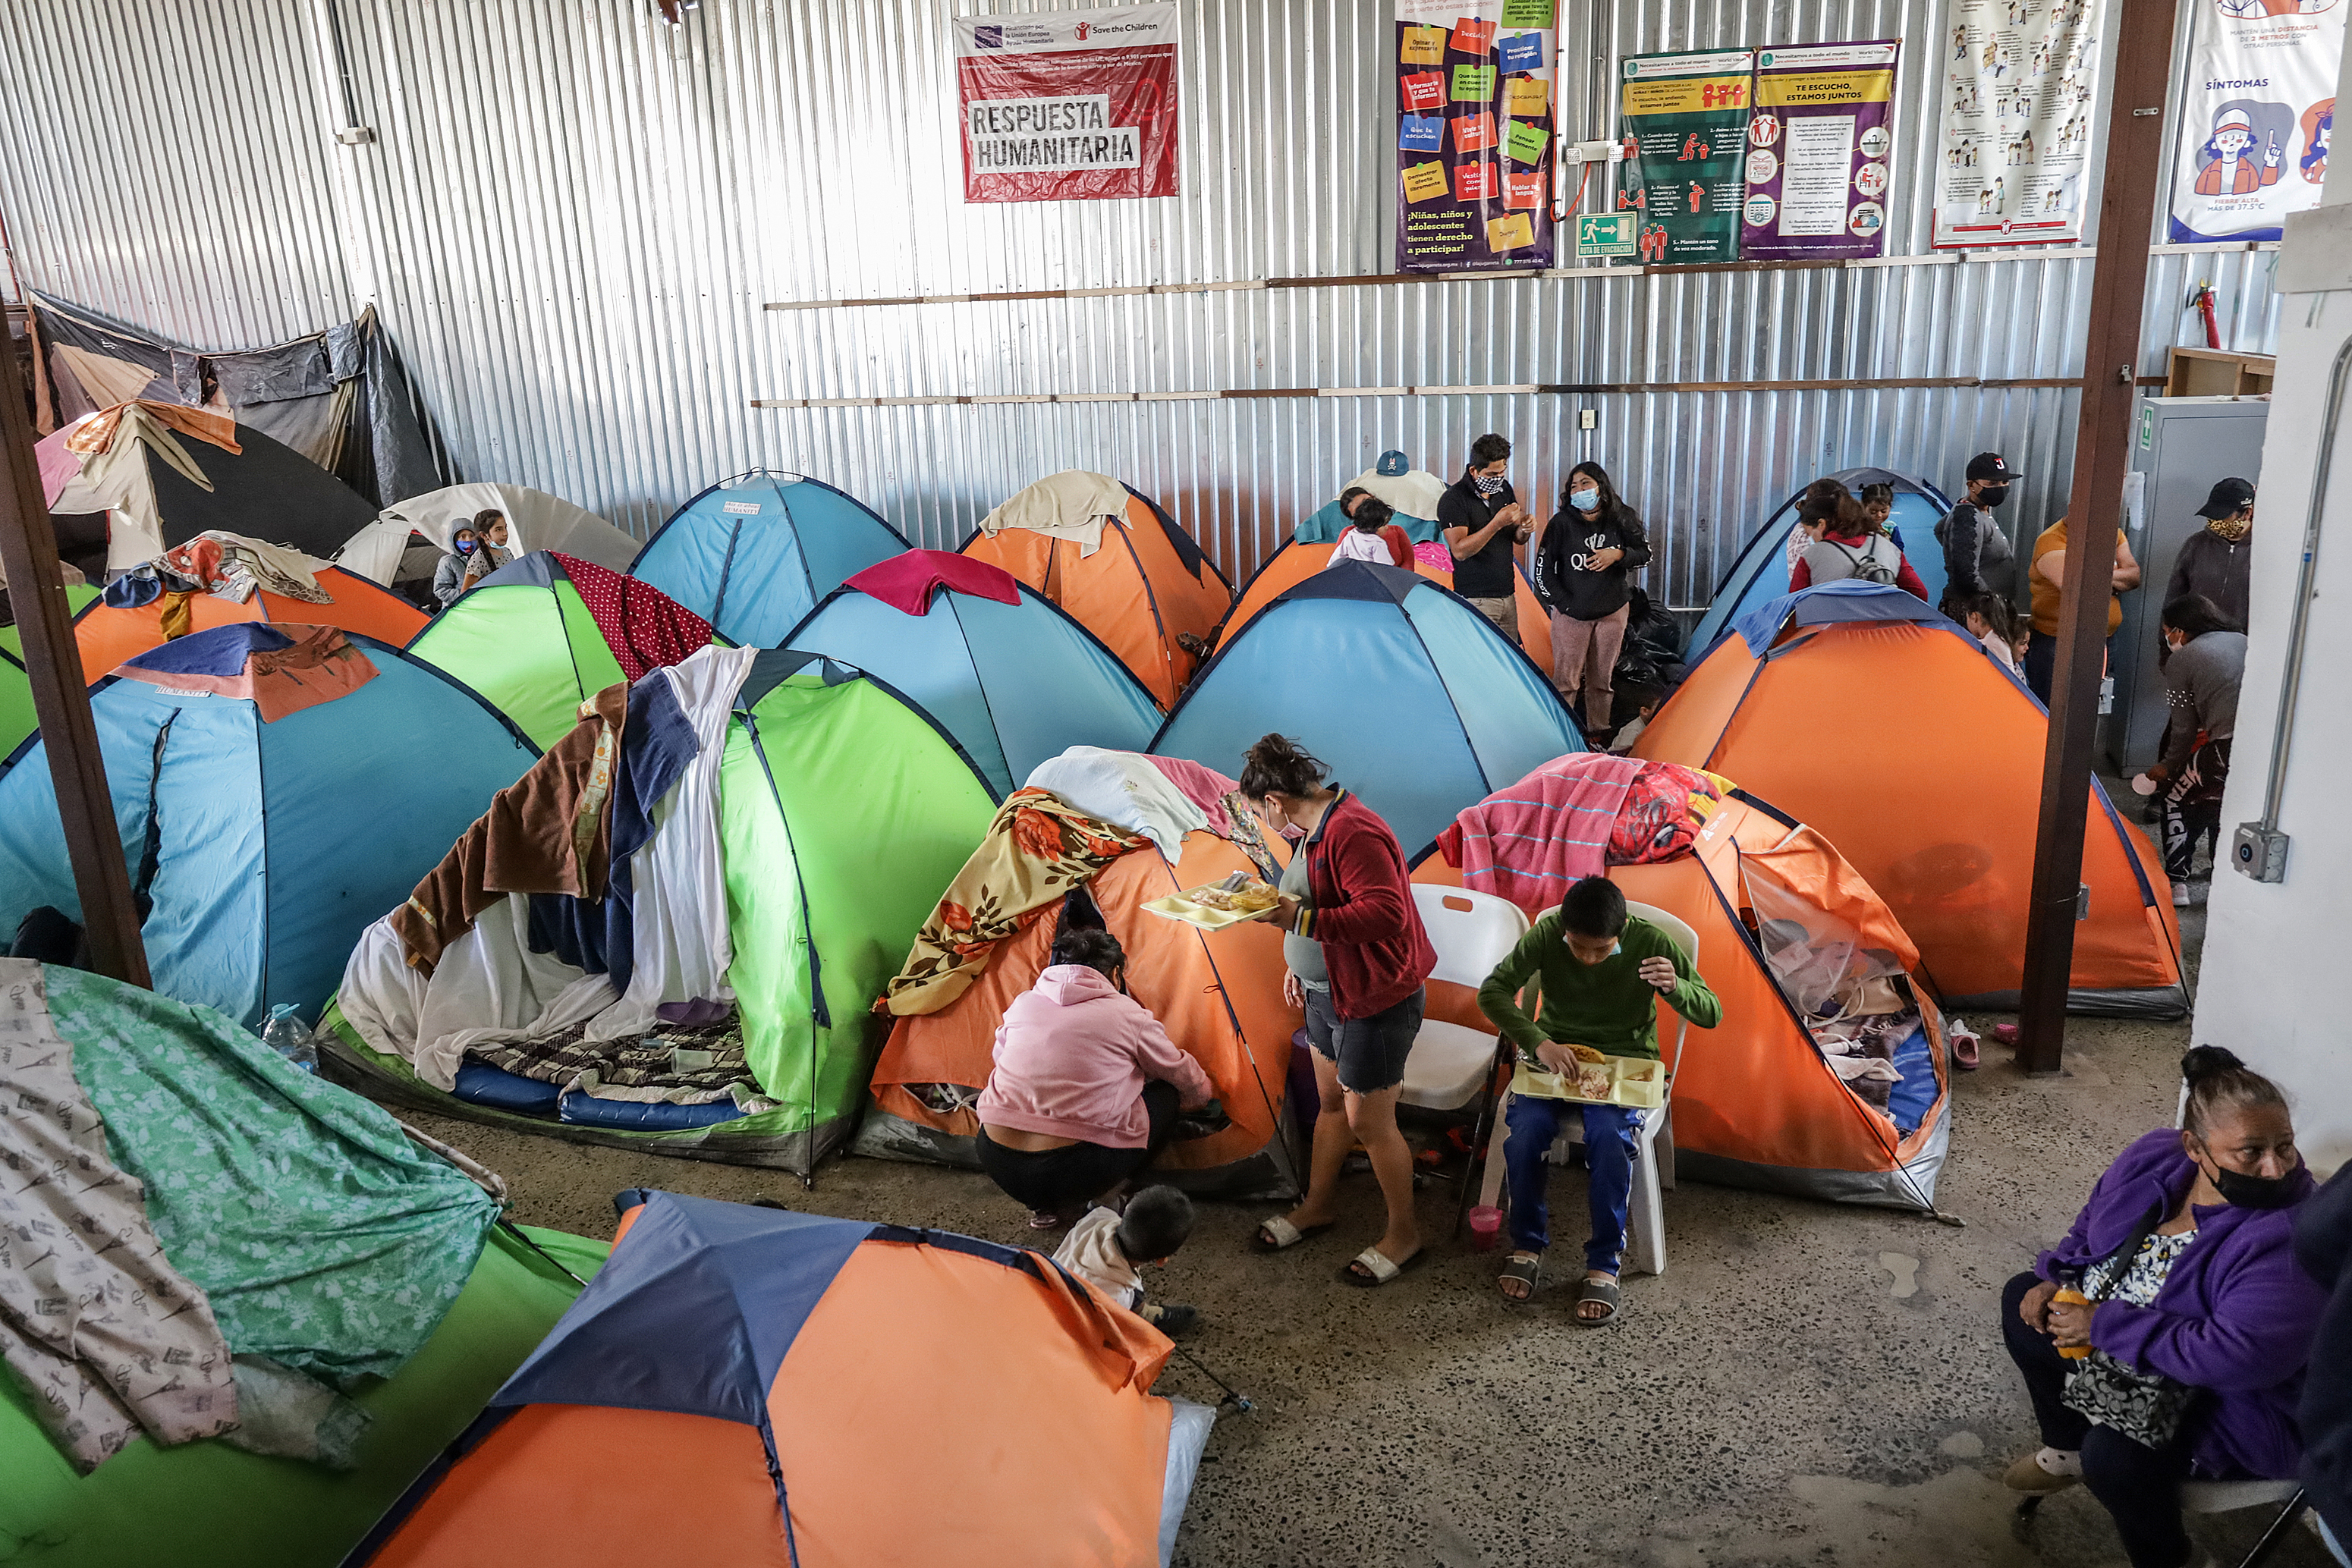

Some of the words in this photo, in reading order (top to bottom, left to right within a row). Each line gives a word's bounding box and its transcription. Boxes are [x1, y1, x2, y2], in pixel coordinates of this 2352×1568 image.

[1125, 24, 1158, 32] Children
[2231, 27, 2259, 36] MANTÉN
[2278, 24, 2319, 33] DISTANCIA
[1461, 30, 1487, 39] Decidir
[1507, 46, 1535, 54] Practicar
[1514, 51, 1538, 59] religión
[1408, 80, 1439, 90] Informarte
[1808, 83, 1852, 91] ESCUCHO,
[2206, 78, 2269, 90] SÍNTOMAS
[1412, 92, 1438, 100] informen
[1786, 93, 1826, 101] ESTAMOS
[1827, 92, 1862, 101] JUNTOS
[973, 101, 1103, 134] RESPUESTA
[1464, 130, 1485, 139] cultura
[1515, 134, 1535, 143] Pensar
[1508, 138, 1538, 152] libremente
[977, 134, 1134, 168] HUMANITARIA
[1407, 169, 1438, 181] Demostrar
[1410, 181, 1441, 192] libremente
[1407, 212, 1439, 222] ¡Niñas,
[1407, 222, 1465, 231] adolescentes
[1435, 232, 1473, 241] derecho
[1498, 229, 1519, 237] Jugar
[1414, 244, 1464, 256] participar!
[1580, 247, 1593, 255] RUTA
[156, 685, 209, 697] HUMANITY
